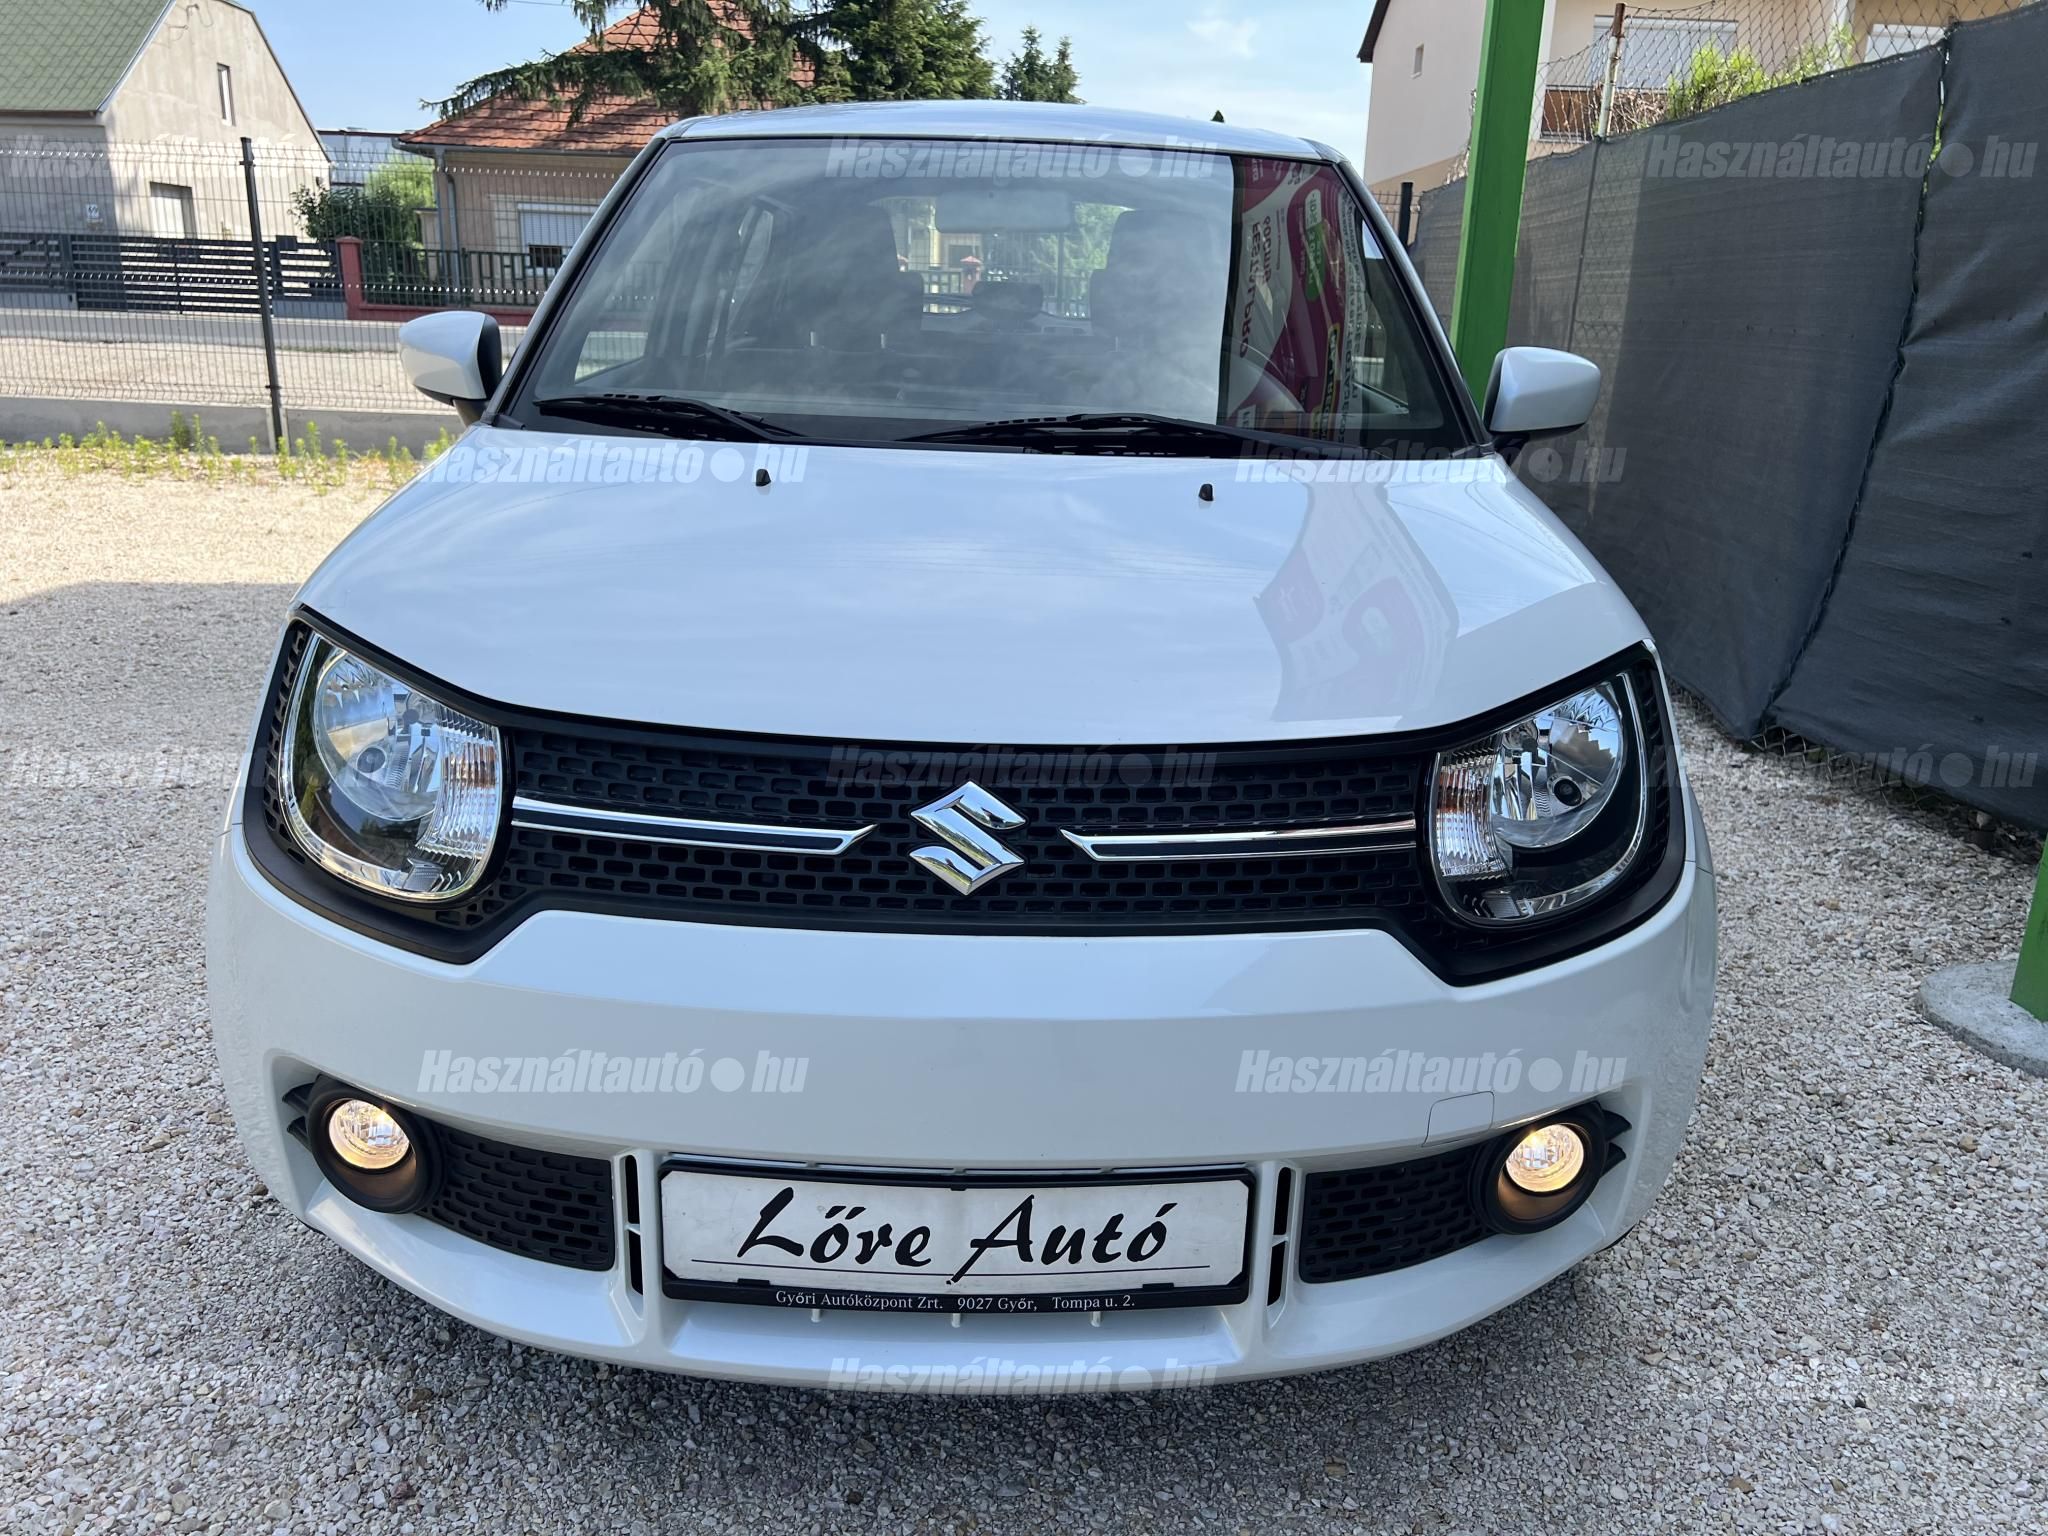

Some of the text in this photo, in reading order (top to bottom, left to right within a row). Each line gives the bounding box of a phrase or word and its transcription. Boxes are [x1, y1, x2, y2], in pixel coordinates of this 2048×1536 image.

[737, 1187, 1178, 1285] Lőre Autó
[776, 1290, 1135, 1312] Győri Autóközpont Zrt. 9027 Győr, Tompa u. 2.
